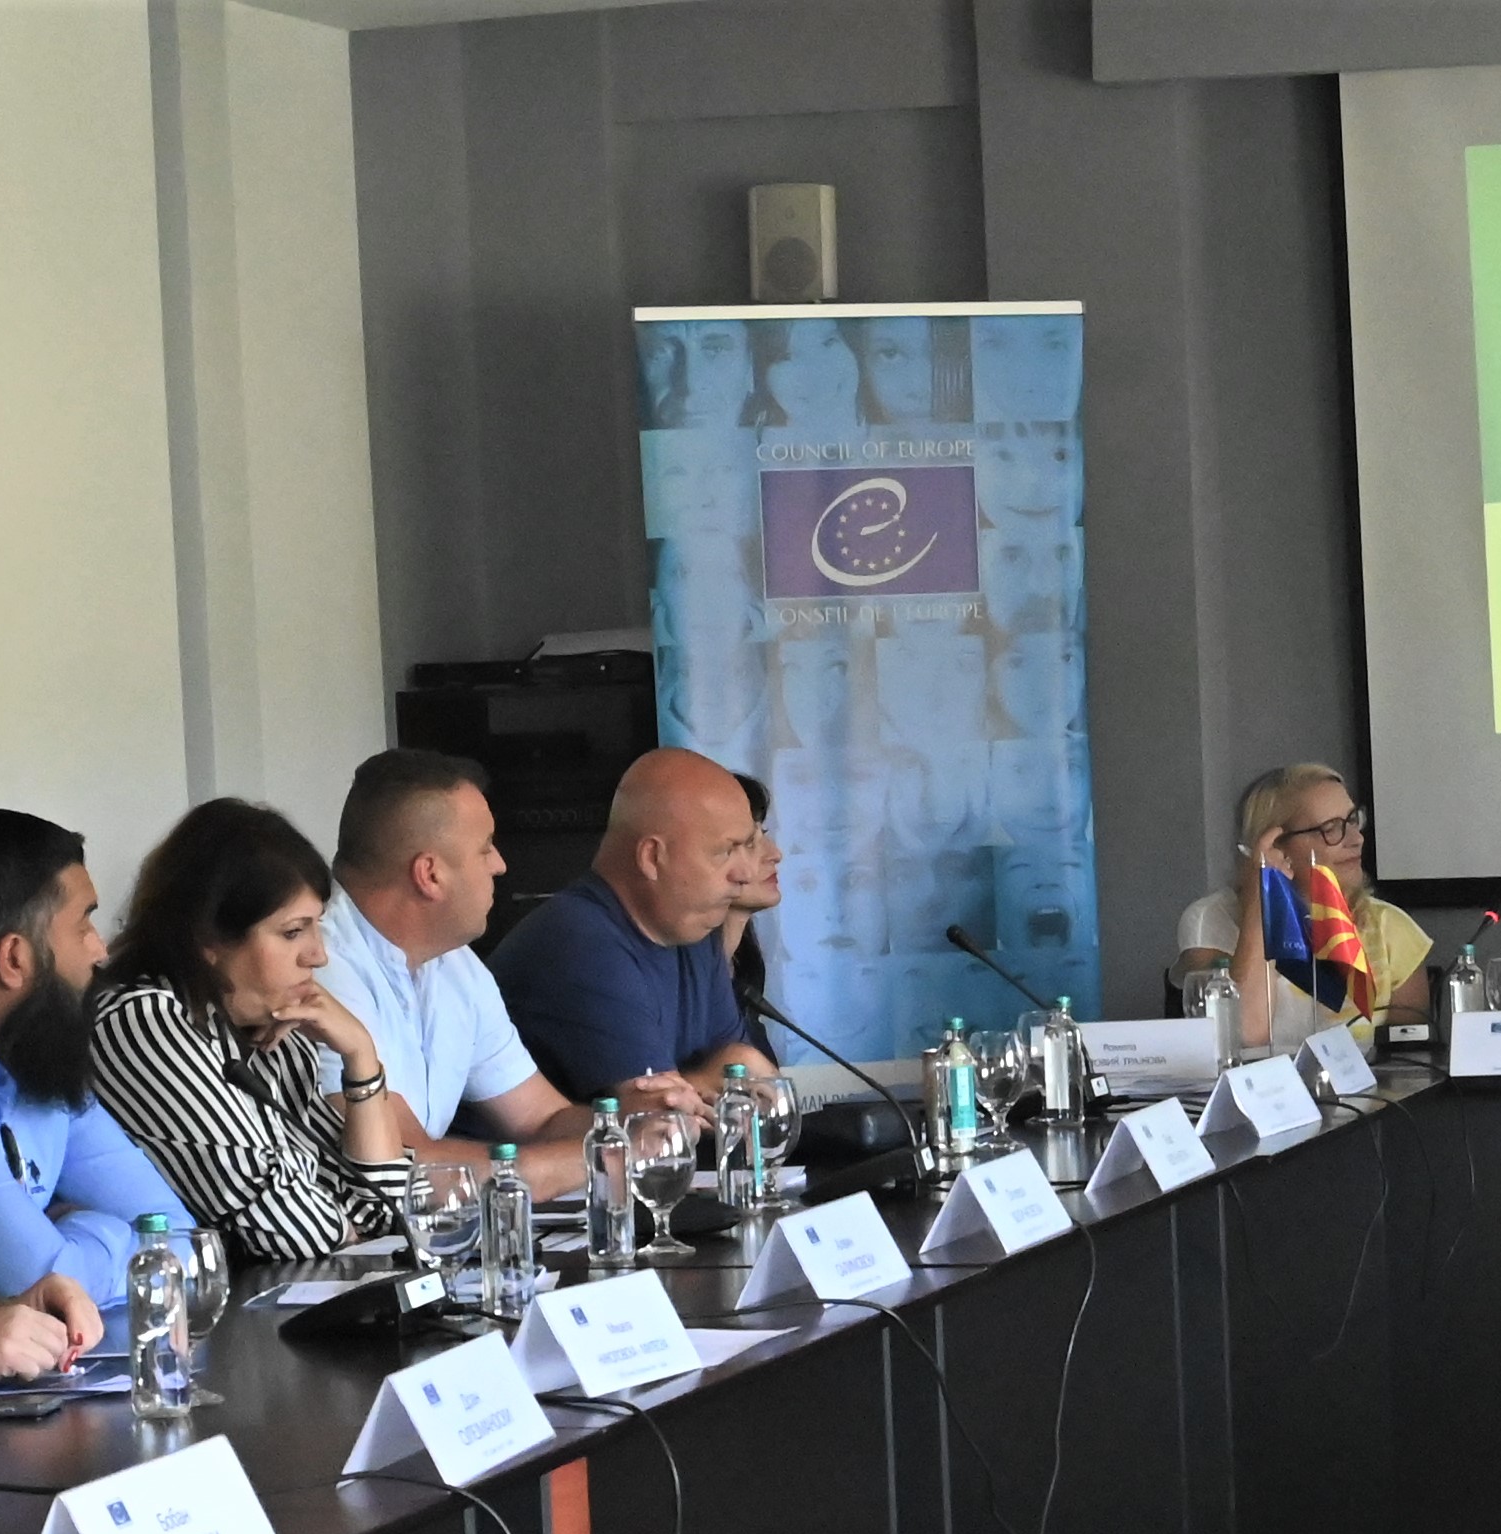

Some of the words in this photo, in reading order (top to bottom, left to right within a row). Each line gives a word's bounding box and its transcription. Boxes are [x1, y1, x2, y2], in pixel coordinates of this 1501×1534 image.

[756, 441, 854, 461] COUNCIL
[862, 441, 890, 459] OF
[899, 439, 975, 457] EUROPE
[860, 604, 886, 622] DE
